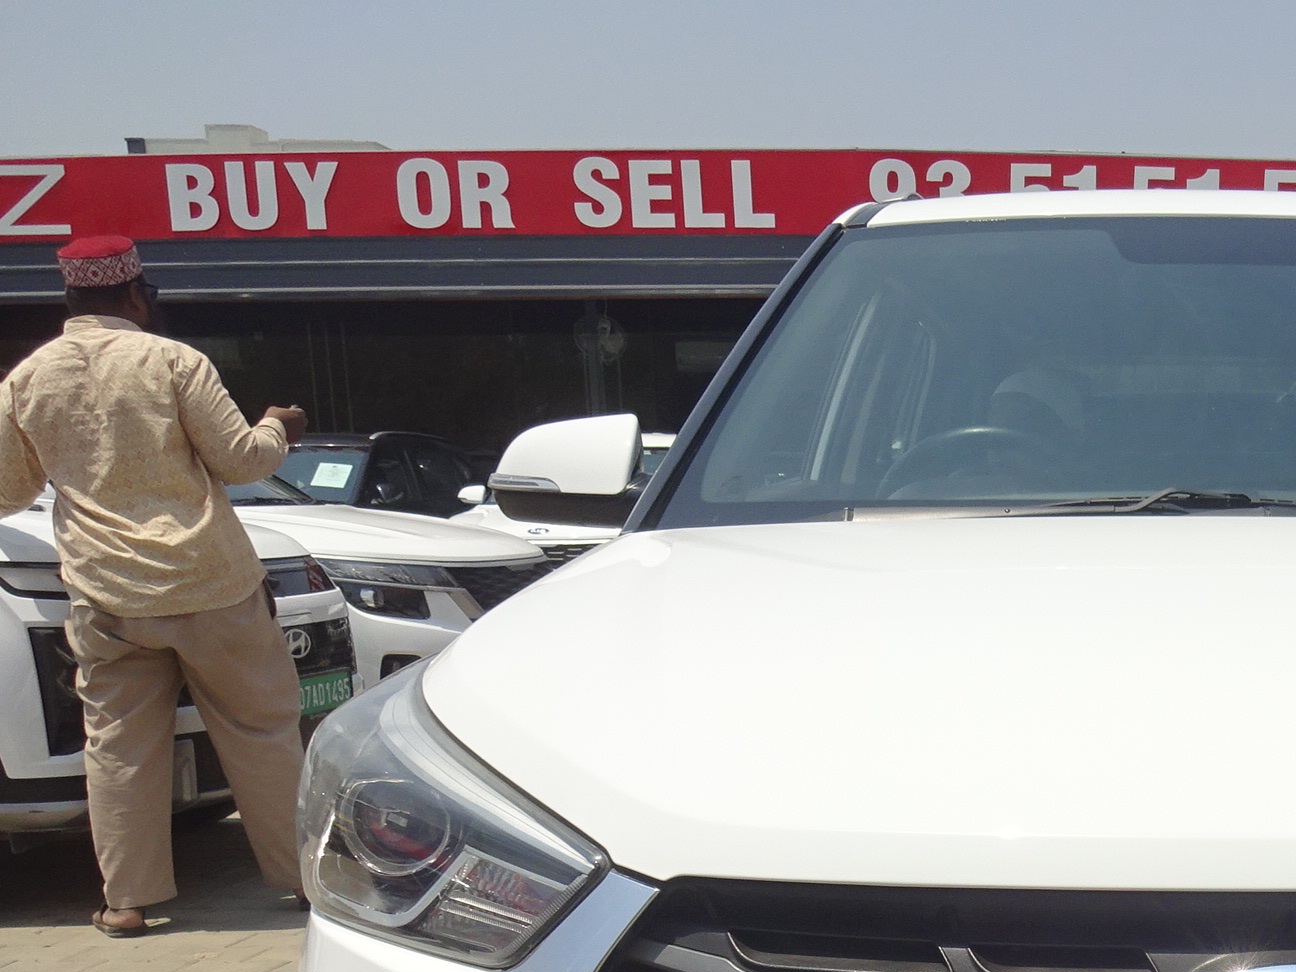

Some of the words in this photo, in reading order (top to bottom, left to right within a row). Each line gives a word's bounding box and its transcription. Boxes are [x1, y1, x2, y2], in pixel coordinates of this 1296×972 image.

[165, 161, 338, 232] BUY
[396, 157, 516, 229] OR
[573, 156, 776, 229] SELL
